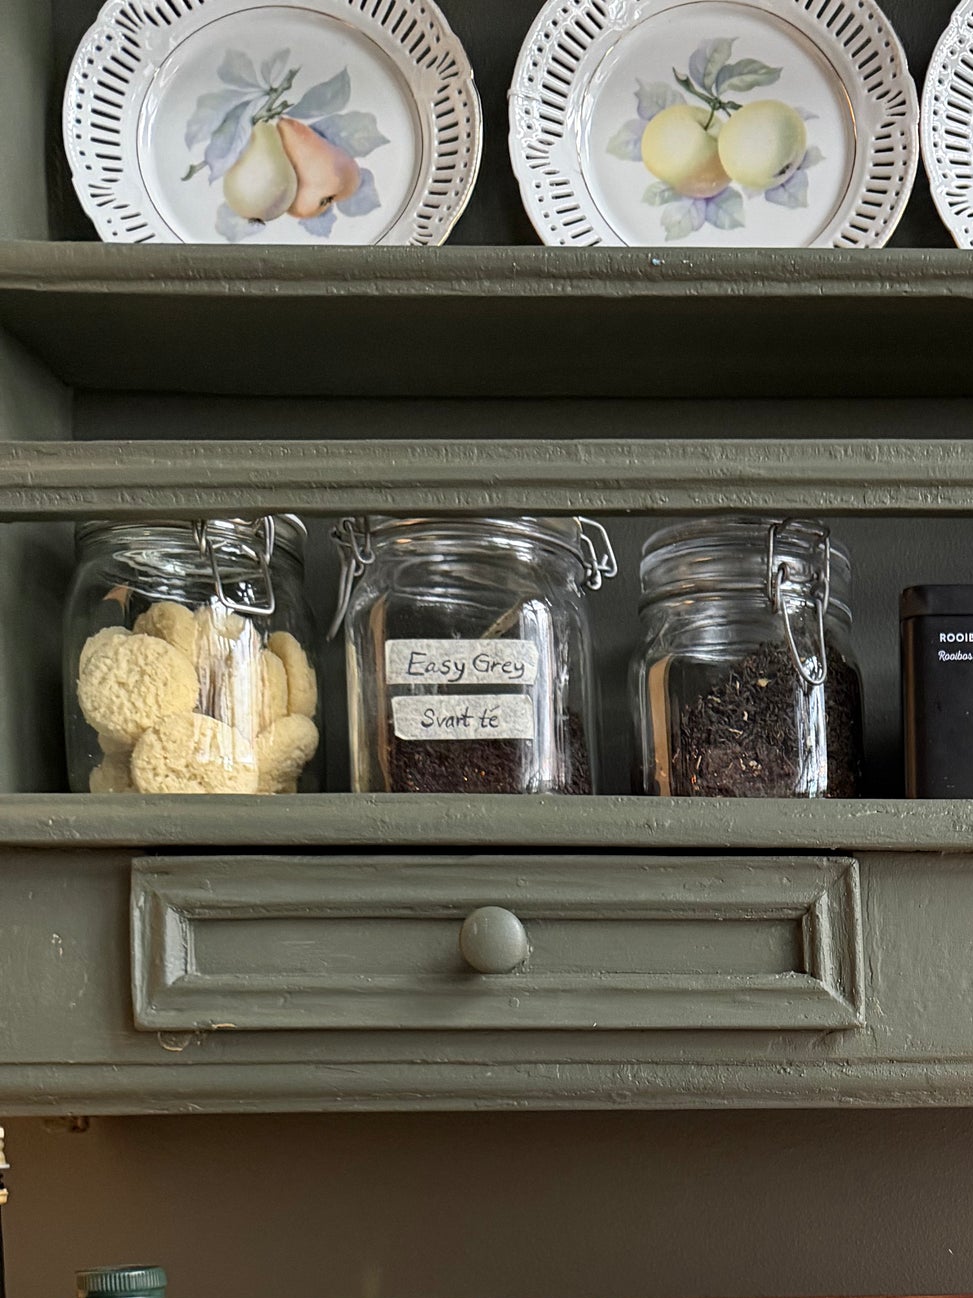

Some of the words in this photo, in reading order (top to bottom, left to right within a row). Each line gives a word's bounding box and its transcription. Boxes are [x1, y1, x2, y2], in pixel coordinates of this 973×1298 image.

[405, 651, 466, 682] Easy
[472, 652, 525, 680] Grey
[420, 706, 475, 729] Svart
[479, 705, 501, 729] té
